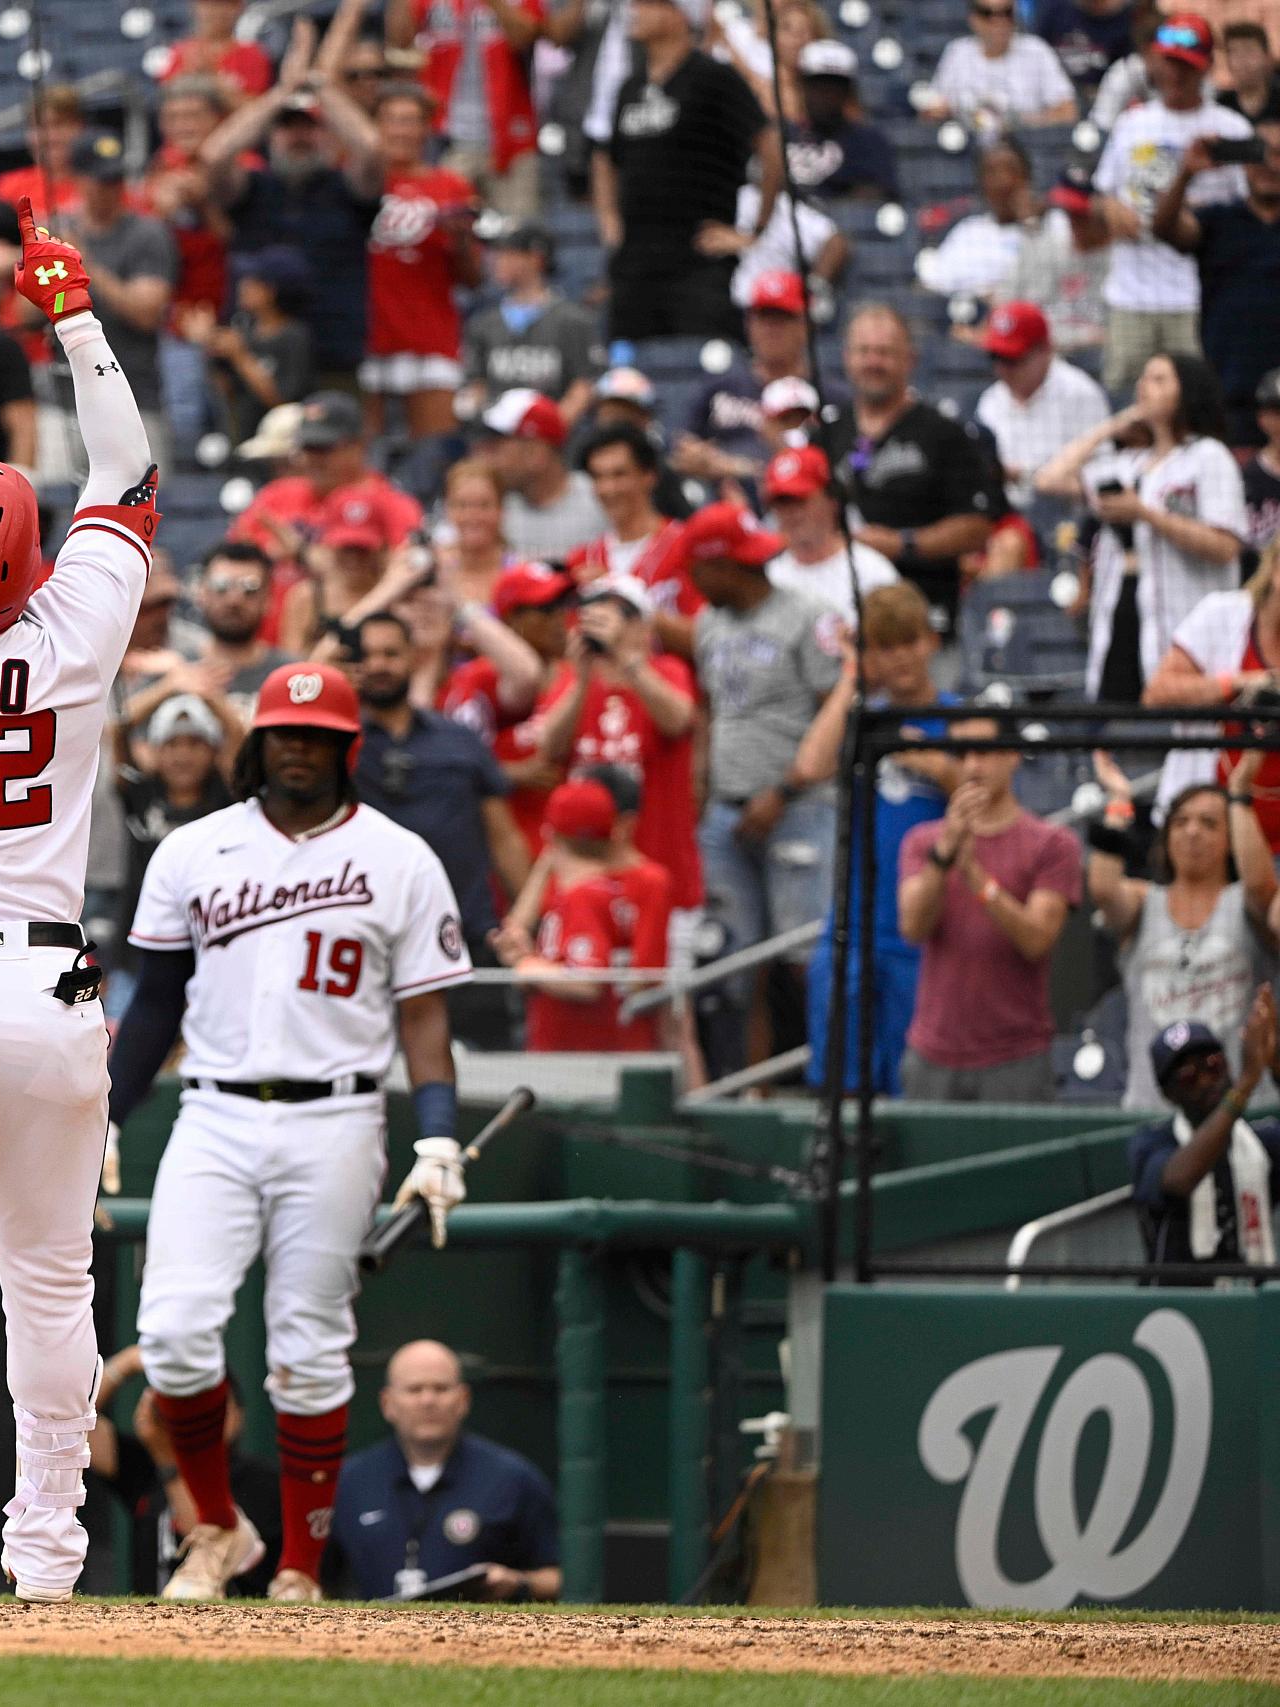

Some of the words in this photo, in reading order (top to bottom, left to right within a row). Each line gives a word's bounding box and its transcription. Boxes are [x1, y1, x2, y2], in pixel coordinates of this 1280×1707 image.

[287, 672, 323, 704] W
[189, 858, 373, 948] Nationals
[74, 986, 94, 1003] 22
[298, 930, 363, 998] 19
[918, 1308, 1213, 1611] W
